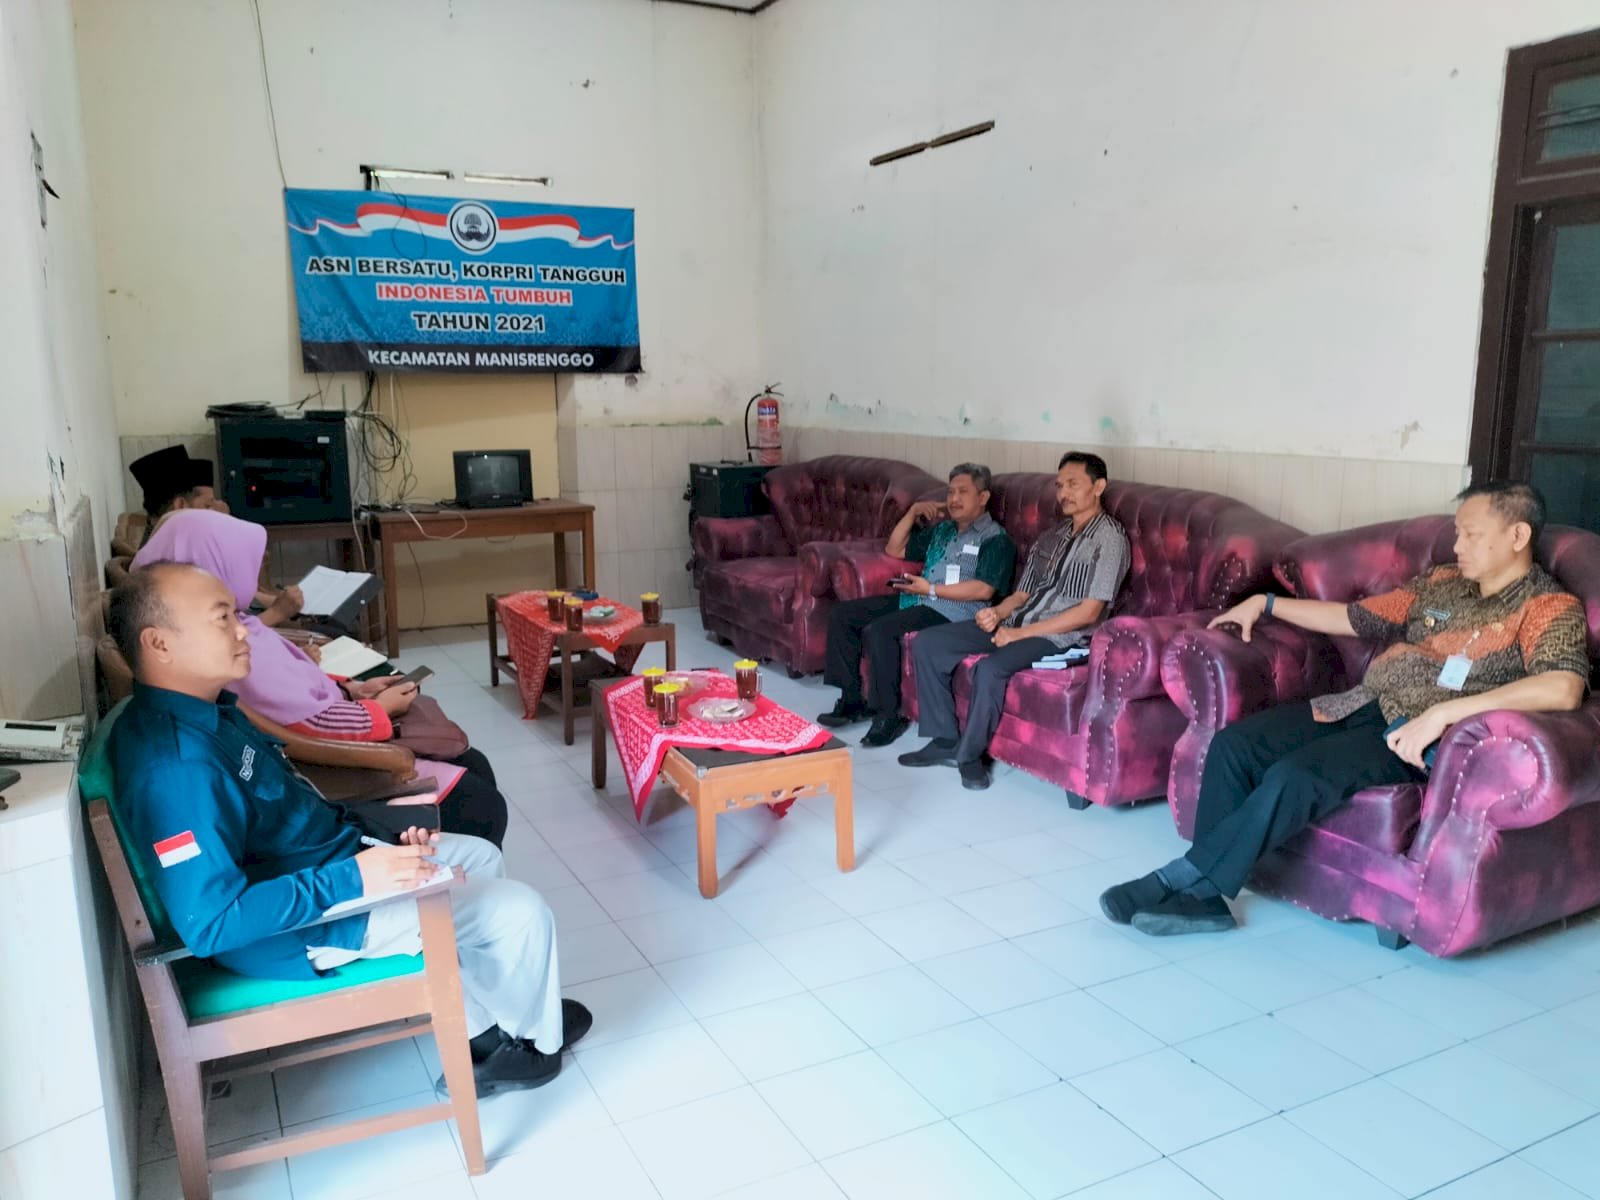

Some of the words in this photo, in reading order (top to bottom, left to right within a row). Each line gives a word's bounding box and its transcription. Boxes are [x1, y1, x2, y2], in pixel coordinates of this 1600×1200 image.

[306, 256, 351, 274] ASN
[357, 258, 457, 280] BERSATU,
[462, 263, 534, 281] KORPRI
[539, 266, 626, 284] TANGGUH
[376, 283, 487, 302] INDONESIA
[492, 288, 572, 305] TUMBUH
[412, 313, 490, 331] TAHUN
[496, 316, 546, 333] 2021
[368, 350, 471, 366] KECAMATAN
[475, 352, 595, 368] MANISRENGGO
